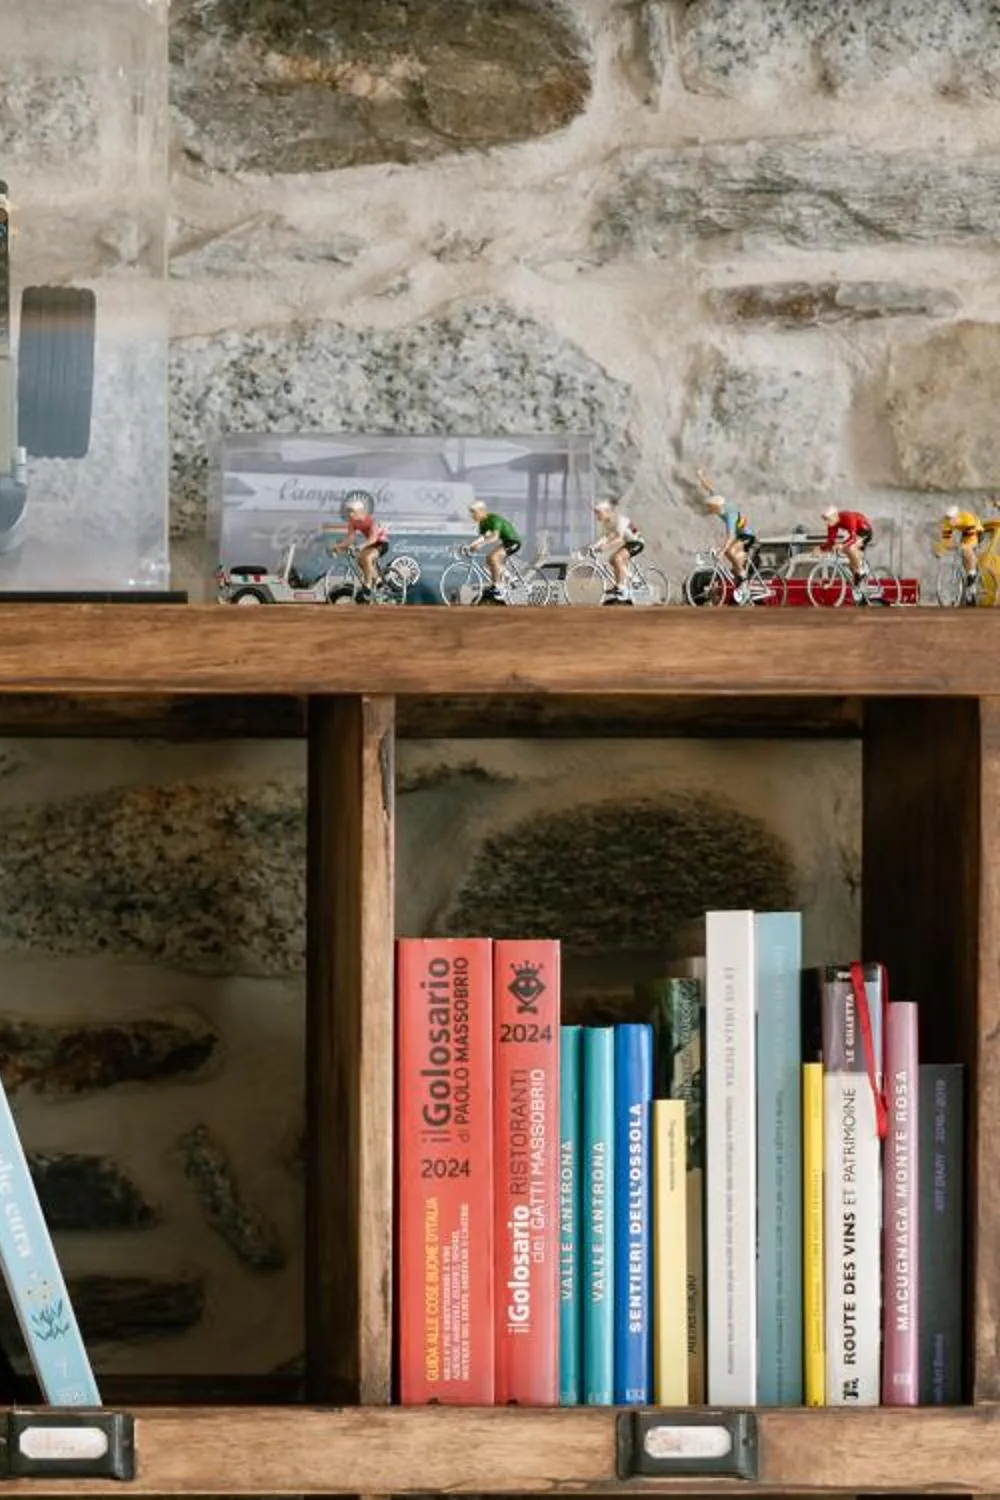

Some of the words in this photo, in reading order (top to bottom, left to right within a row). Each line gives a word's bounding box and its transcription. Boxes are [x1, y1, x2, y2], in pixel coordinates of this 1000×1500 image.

[453, 956, 469, 1062] MASSOBRIO
[499, 1023, 552, 1043] 2024
[419, 958, 451, 1142] ilGolosario
[453, 1066, 470, 1124] PAOLO
[529, 1069, 545, 1175] MASSOBRIO
[895, 1070, 909, 1121] ROSA
[456, 1127, 471, 1143] di
[509, 1069, 528, 1195] RISTORANTI
[842, 1089, 856, 1182] PATRIMOINE
[420, 1158, 471, 1179] 2024
[559, 1140, 573, 1232] ANTRONA
[592, 1141, 605, 1235] ANTRONA
[629, 1103, 642, 1234] DELL'OSSOLA
[895, 1128, 909, 1197] MONTE
[529, 1180, 545, 1229] GATTI
[842, 1189, 856, 1205] ET
[424, 1243, 439, 1282] BUONE
[843, 1212, 855, 1256] VINS
[507, 1205, 530, 1332] ilGolosario
[561, 1242, 573, 1300] VALLE
[592, 1243, 605, 1303] VALLE
[629, 1242, 642, 1332] SENTIERI
[843, 1261, 855, 1295] DES
[895, 1205, 910, 1330] MACUGNAGA
[424, 1284, 439, 1314] COSE
[425, 1316, 439, 1344] ALLE
[843, 1303, 856, 1364] ROUTE
[425, 1347, 439, 1381] GUIDA
